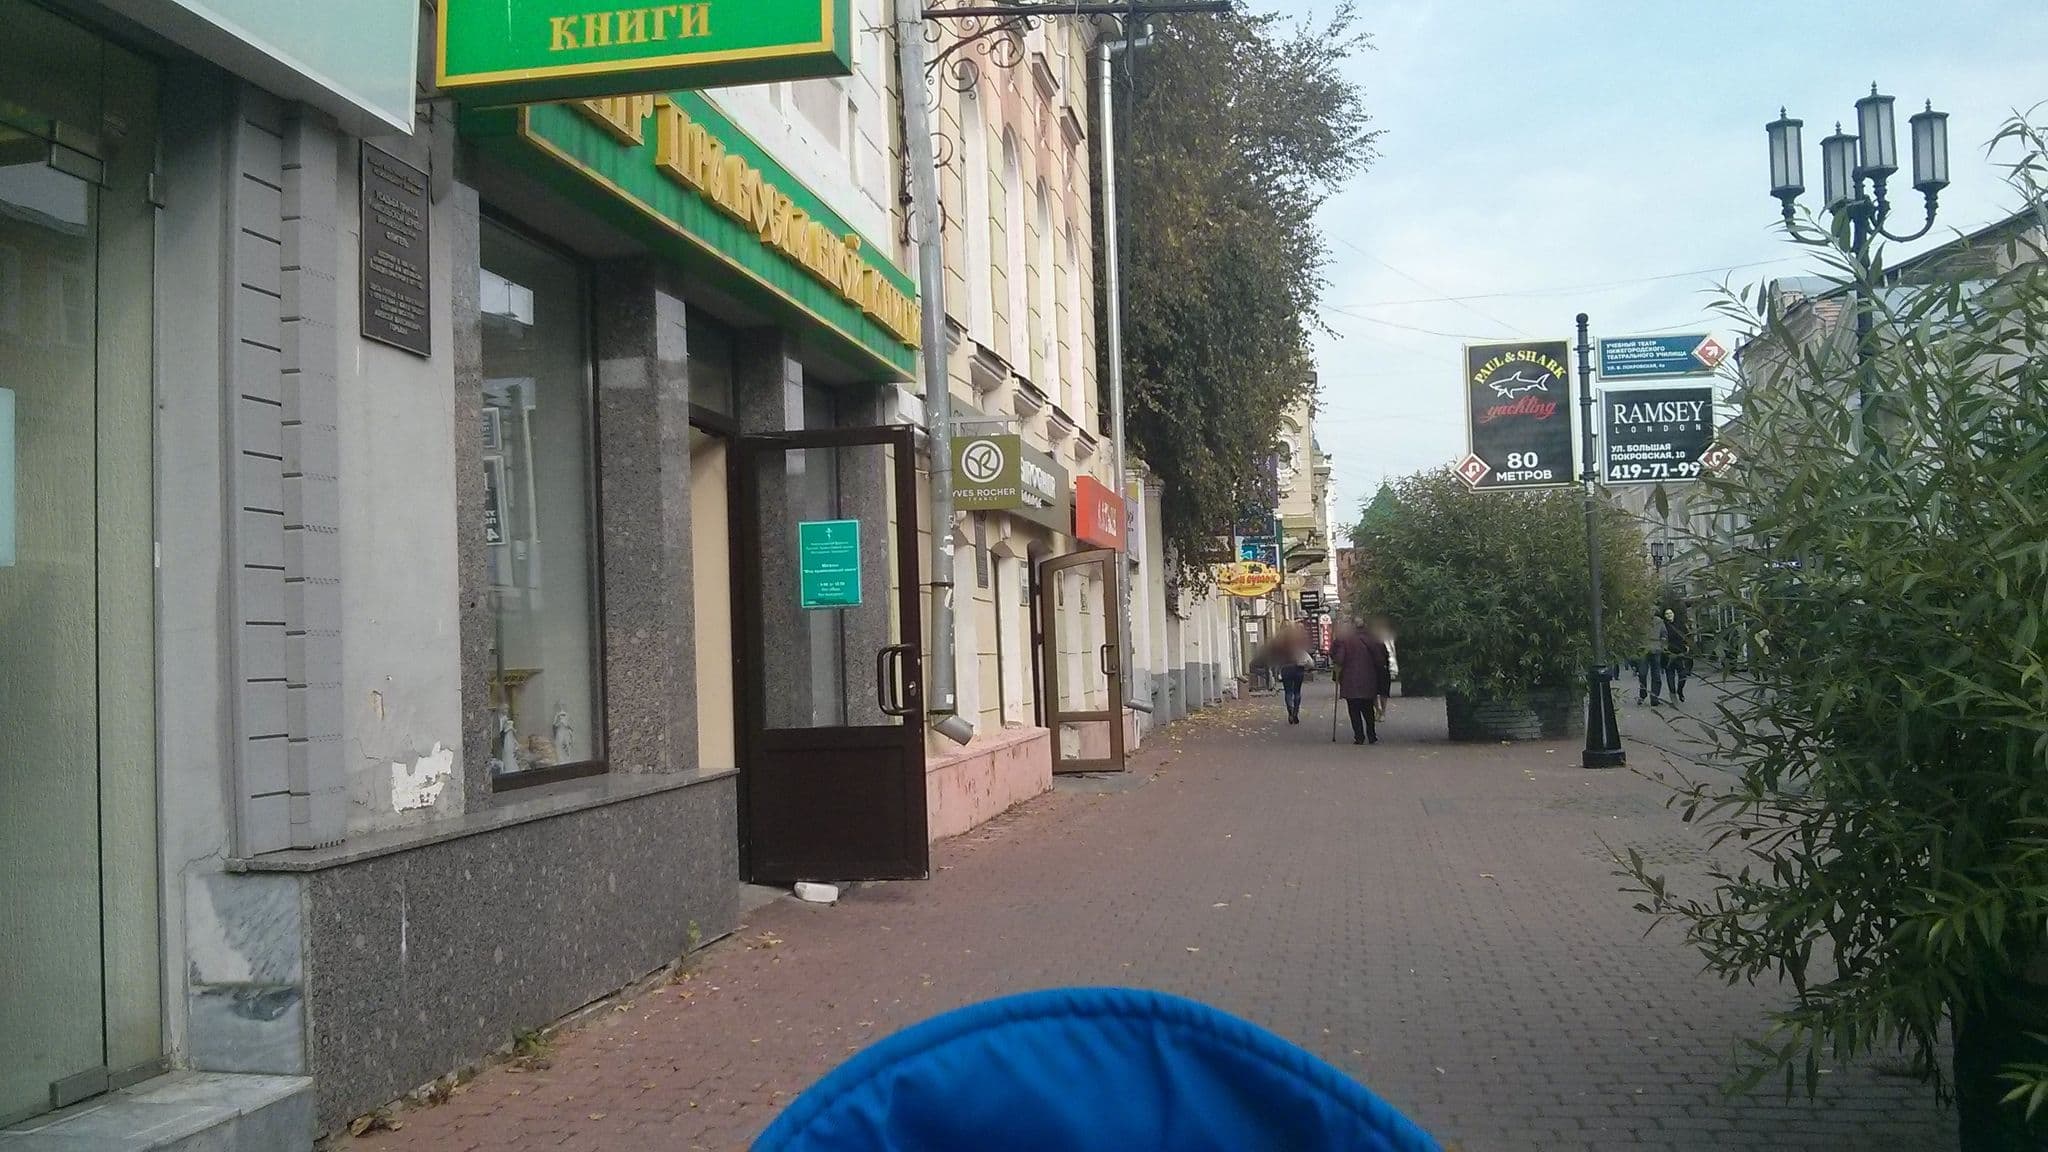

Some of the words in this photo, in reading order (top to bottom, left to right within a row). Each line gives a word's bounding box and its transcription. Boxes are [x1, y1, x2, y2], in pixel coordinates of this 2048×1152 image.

[549, 3, 712, 51] КНИГИ
[1606, 352, 1655, 360] ТЕАТРАЛЬНОГО
[1613, 400, 1705, 424] RAMSEY
[1615, 423, 1702, 434] LONDON
[1611, 445, 1626, 453] УЛ.
[1626, 443, 1672, 452] БОЛЬШАЯ
[1507, 451, 1538, 469] 80
[1610, 452, 1674, 461] ПОКРОВСКАЯ,
[1675, 451, 1685, 459] 10
[1496, 469, 1553, 482] МЕТРОВ
[1610, 462, 1701, 479] 419-71-99
[976, 487, 1016, 497] ROCHER
